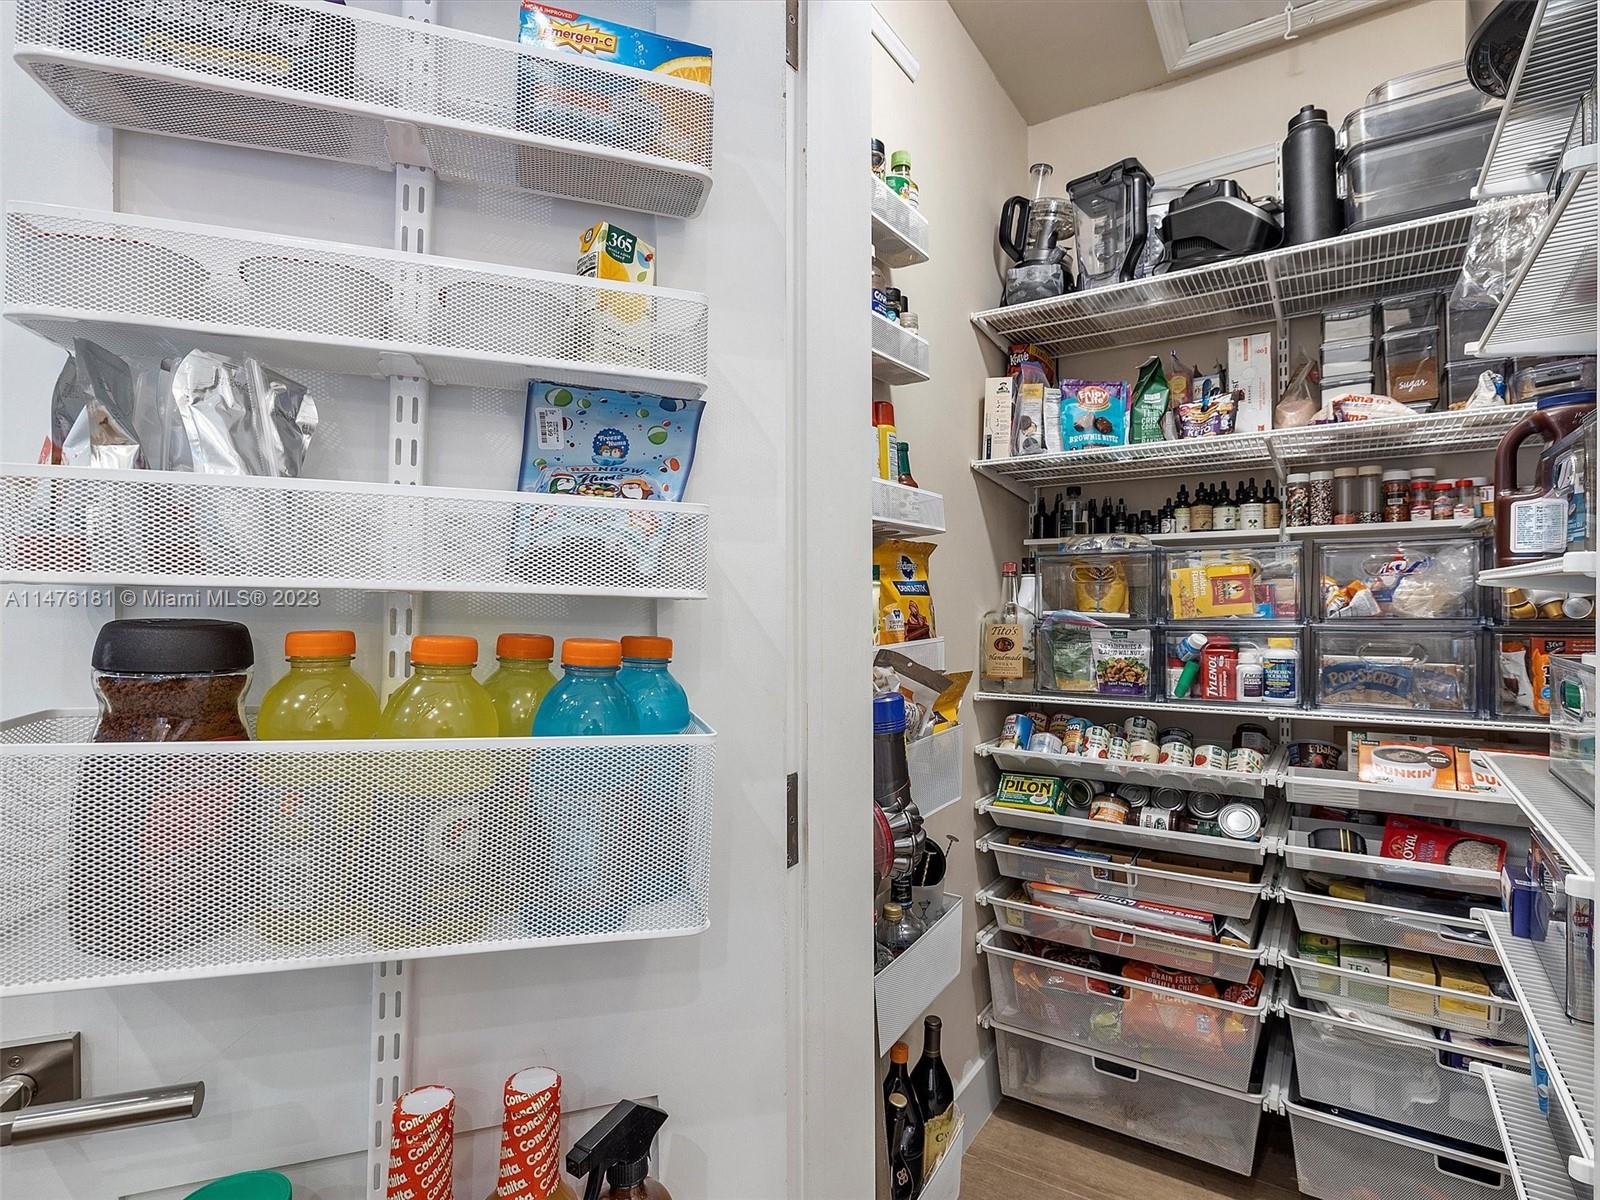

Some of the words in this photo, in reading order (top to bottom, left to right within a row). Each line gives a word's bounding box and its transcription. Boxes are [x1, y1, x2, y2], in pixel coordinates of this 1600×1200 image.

[544, 7, 573, 19] IMPROVED
[607, 232, 634, 254] 365
[1398, 376, 1429, 393] sugar
[570, 465, 644, 475] RAINBOW
[991, 626, 1018, 636] Tito's
[988, 653, 1022, 661] Handmade
[1206, 655, 1217, 697] TYLENOL
[1328, 671, 1355, 687] POP
[1358, 669, 1407, 689] SECRET
[1374, 764, 1436, 779] DUNKIN'
[1004, 779, 1052, 795] PILON
[1137, 904, 1175, 915] STORAGE
[1174, 910, 1205, 921] SLIDER
[1346, 962, 1371, 974] TEA
[1151, 971, 1173, 983] GRAIN
[1175, 974, 1192, 985] FREE
[1177, 983, 1200, 993] CHIPS
[513, 1103, 554, 1137] Conchi
[519, 1111, 558, 1152] Conchita
[408, 1129, 441, 1160] Conchi
[414, 1132, 451, 1175] Conchita
[533, 1140, 560, 1178] Conchi
